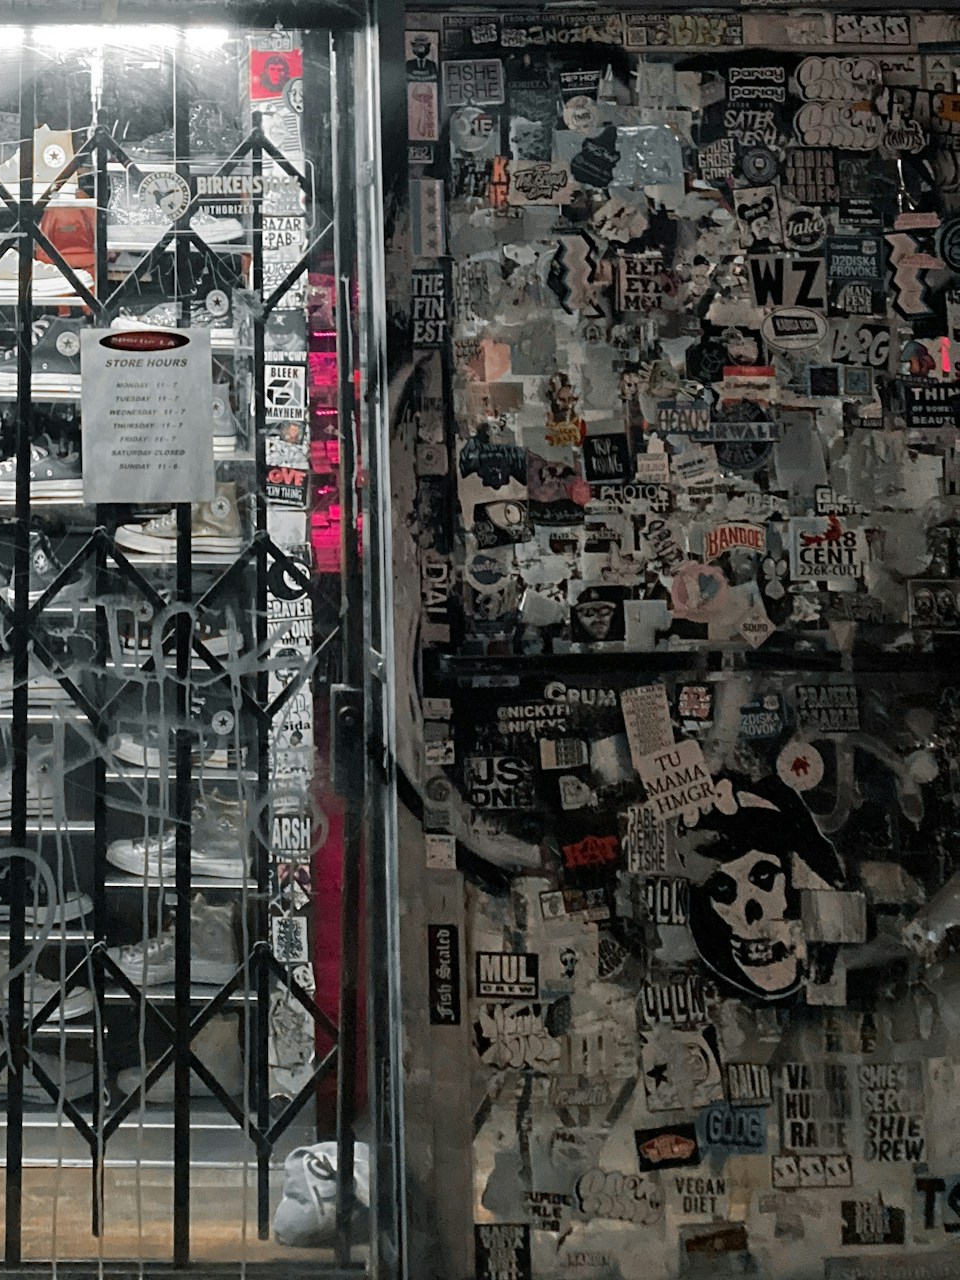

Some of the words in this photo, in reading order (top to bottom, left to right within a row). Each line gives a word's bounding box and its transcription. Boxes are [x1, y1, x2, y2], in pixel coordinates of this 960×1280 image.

[447, 64, 498, 81] FISHE
[448, 82, 499, 99] FISHE
[196, 175, 301, 195] BIRKENSTOCK
[262, 218, 301, 231] BAZAR
[412, 273, 445, 296] THE
[413, 297, 445, 320] FIN
[413, 320, 446, 343] EST
[105, 358, 144, 368] STORE
[146, 358, 189, 368] HOURS
[271, 367, 299, 378] BLEEK
[265, 407, 303, 419] MAYHEM
[266, 468, 307, 487] OVE
[799, 548, 858, 564] CENT
[654, 751, 681, 771] TU
[645, 764, 706, 801] MAMA
[675, 1177, 726, 1195] VEGAN
[683, 1196, 718, 1213] DIET
